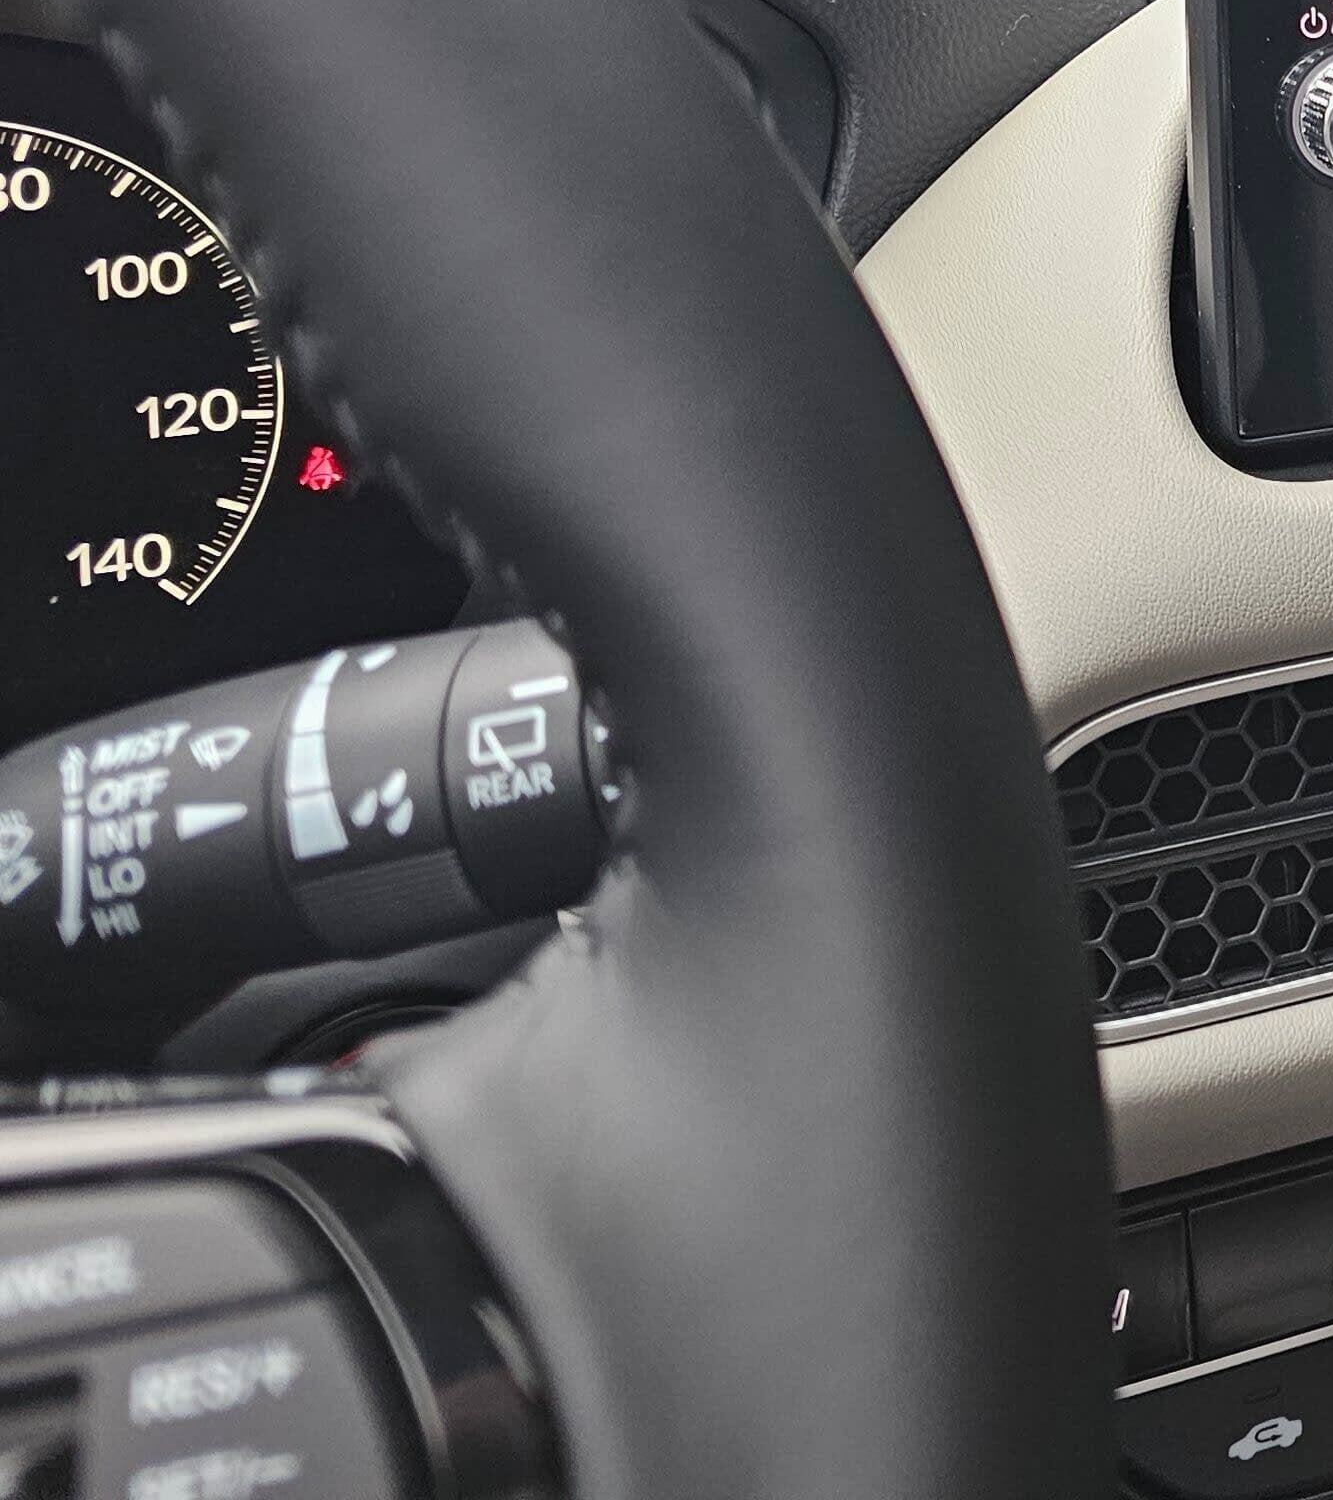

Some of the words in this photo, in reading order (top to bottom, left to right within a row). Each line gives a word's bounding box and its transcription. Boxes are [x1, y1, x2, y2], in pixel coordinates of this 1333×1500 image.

[84, 251, 189, 302] 100
[135, 387, 239, 440] 120
[66, 533, 173, 588] 140
[89, 720, 192, 775] MIST
[86, 766, 171, 818] OFF
[465, 762, 556, 811] REAR
[88, 809, 160, 861] INT
[88, 857, 147, 902] LO
